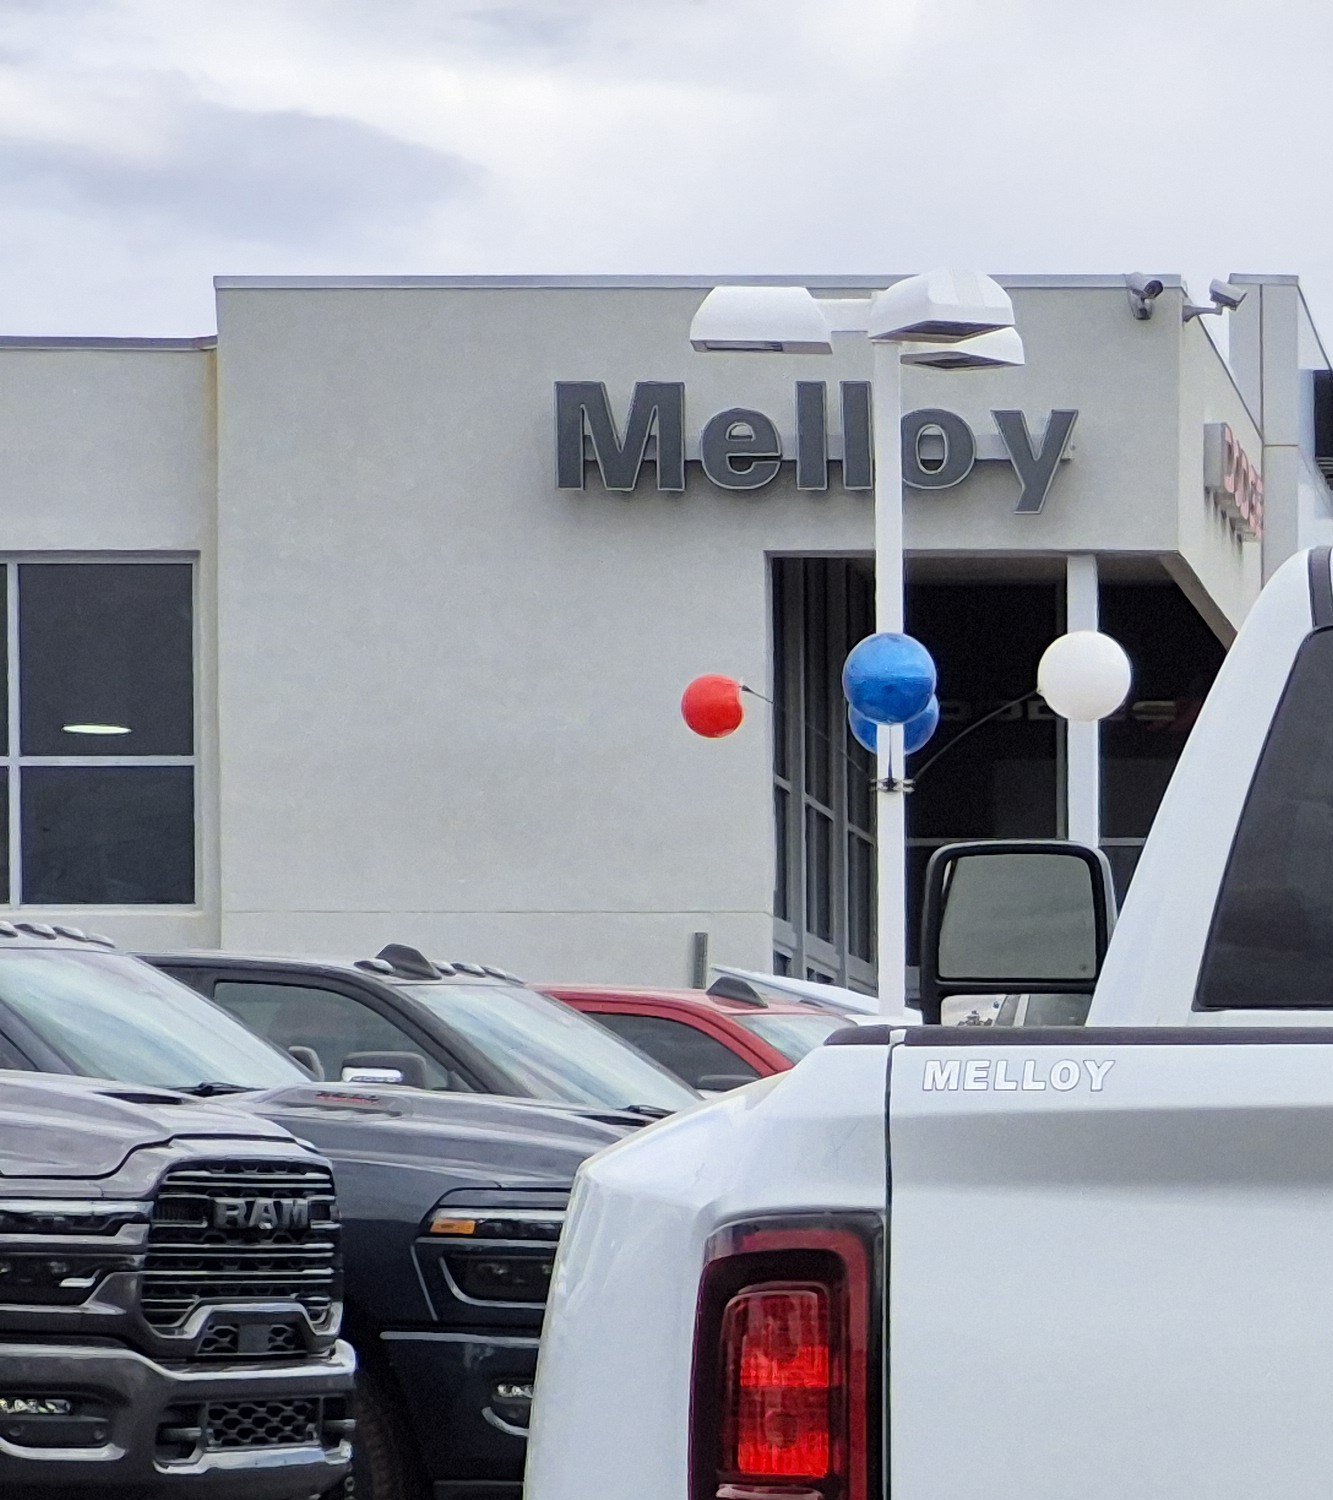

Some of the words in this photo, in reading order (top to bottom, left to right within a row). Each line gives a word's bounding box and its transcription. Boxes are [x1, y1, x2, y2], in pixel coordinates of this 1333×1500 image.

[555, 381, 1079, 514] Melloy
[922, 1059, 1116, 1091] MELLOY
[213, 1197, 308, 1228] RAM
